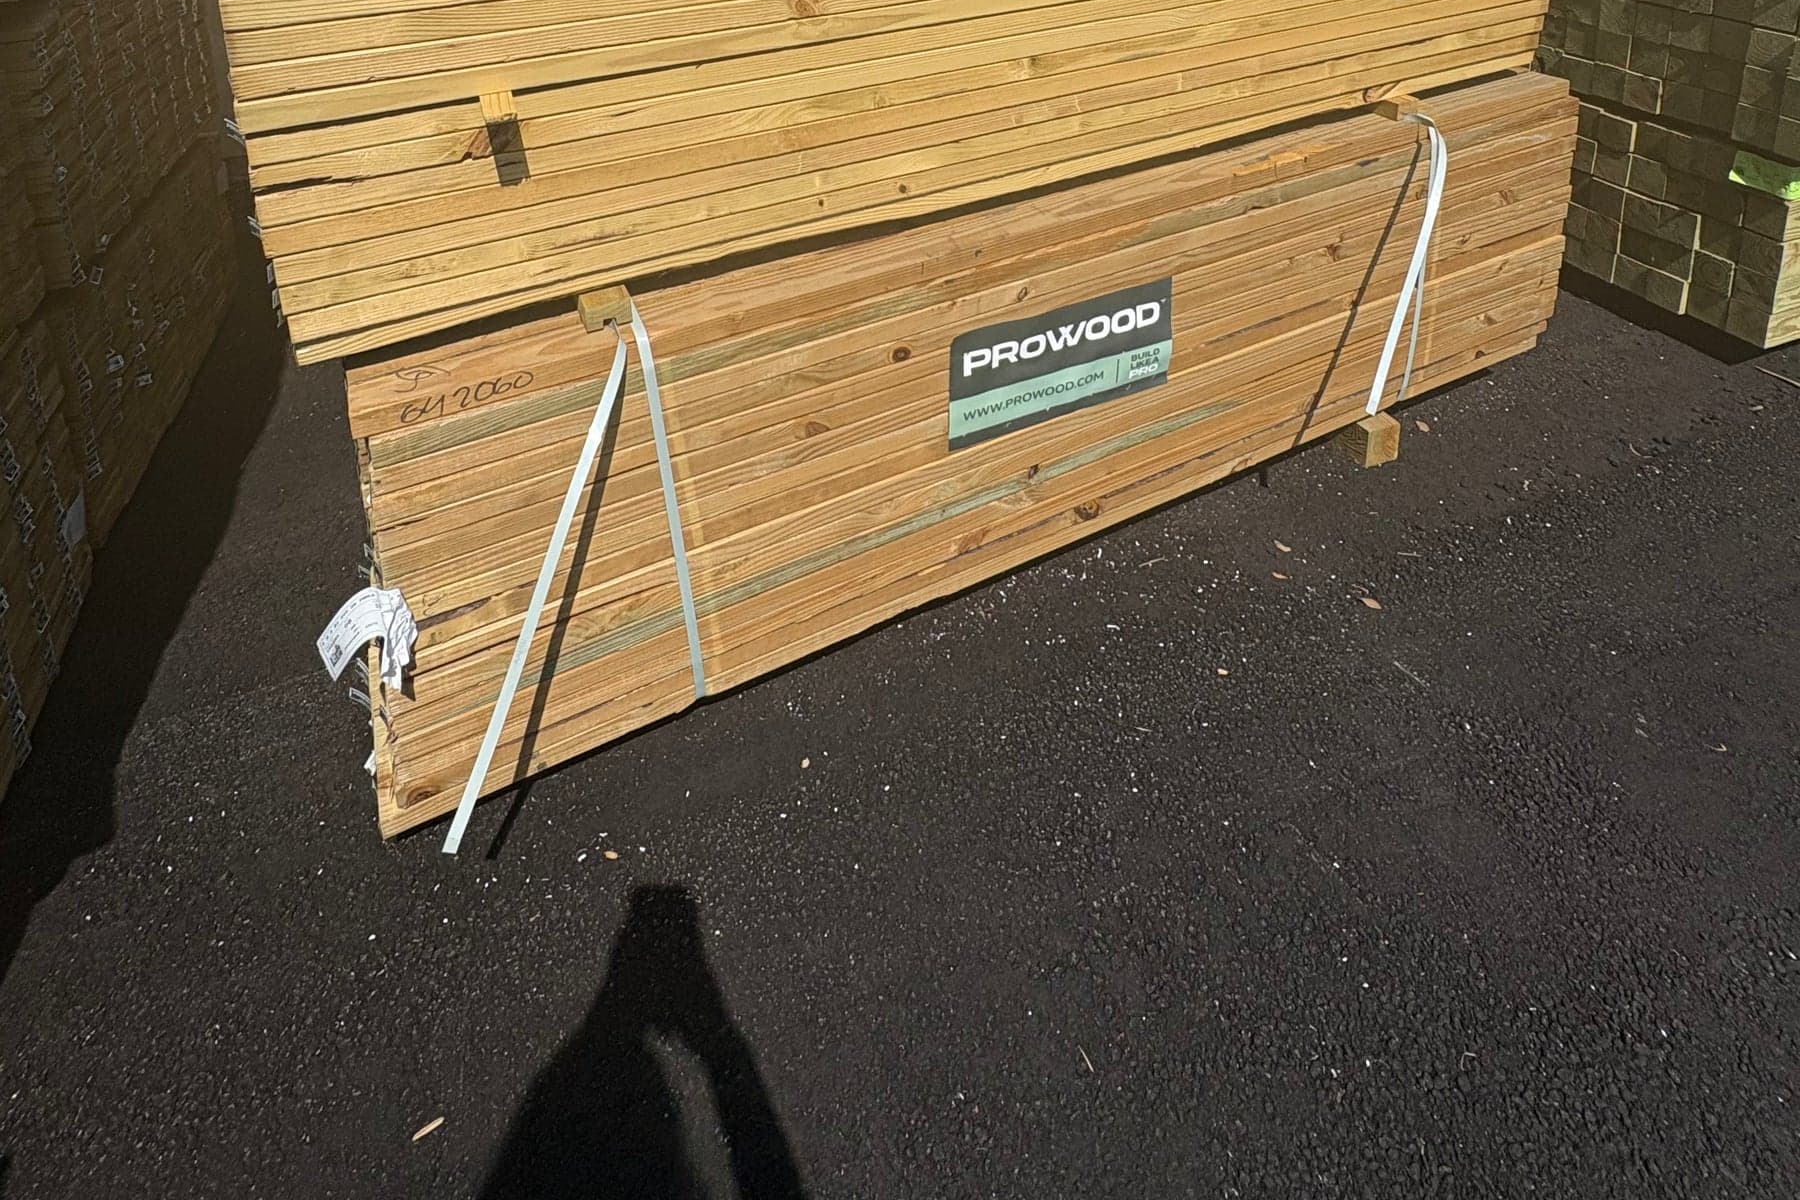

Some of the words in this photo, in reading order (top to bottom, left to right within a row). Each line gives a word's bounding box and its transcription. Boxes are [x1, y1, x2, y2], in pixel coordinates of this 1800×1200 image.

[963, 301, 1161, 377] PROWOOD
[1131, 347, 1160, 362] BUILD
[1129, 363, 1158, 379] PRO
[963, 370, 1105, 421] WWW.PROWOOD.COM
